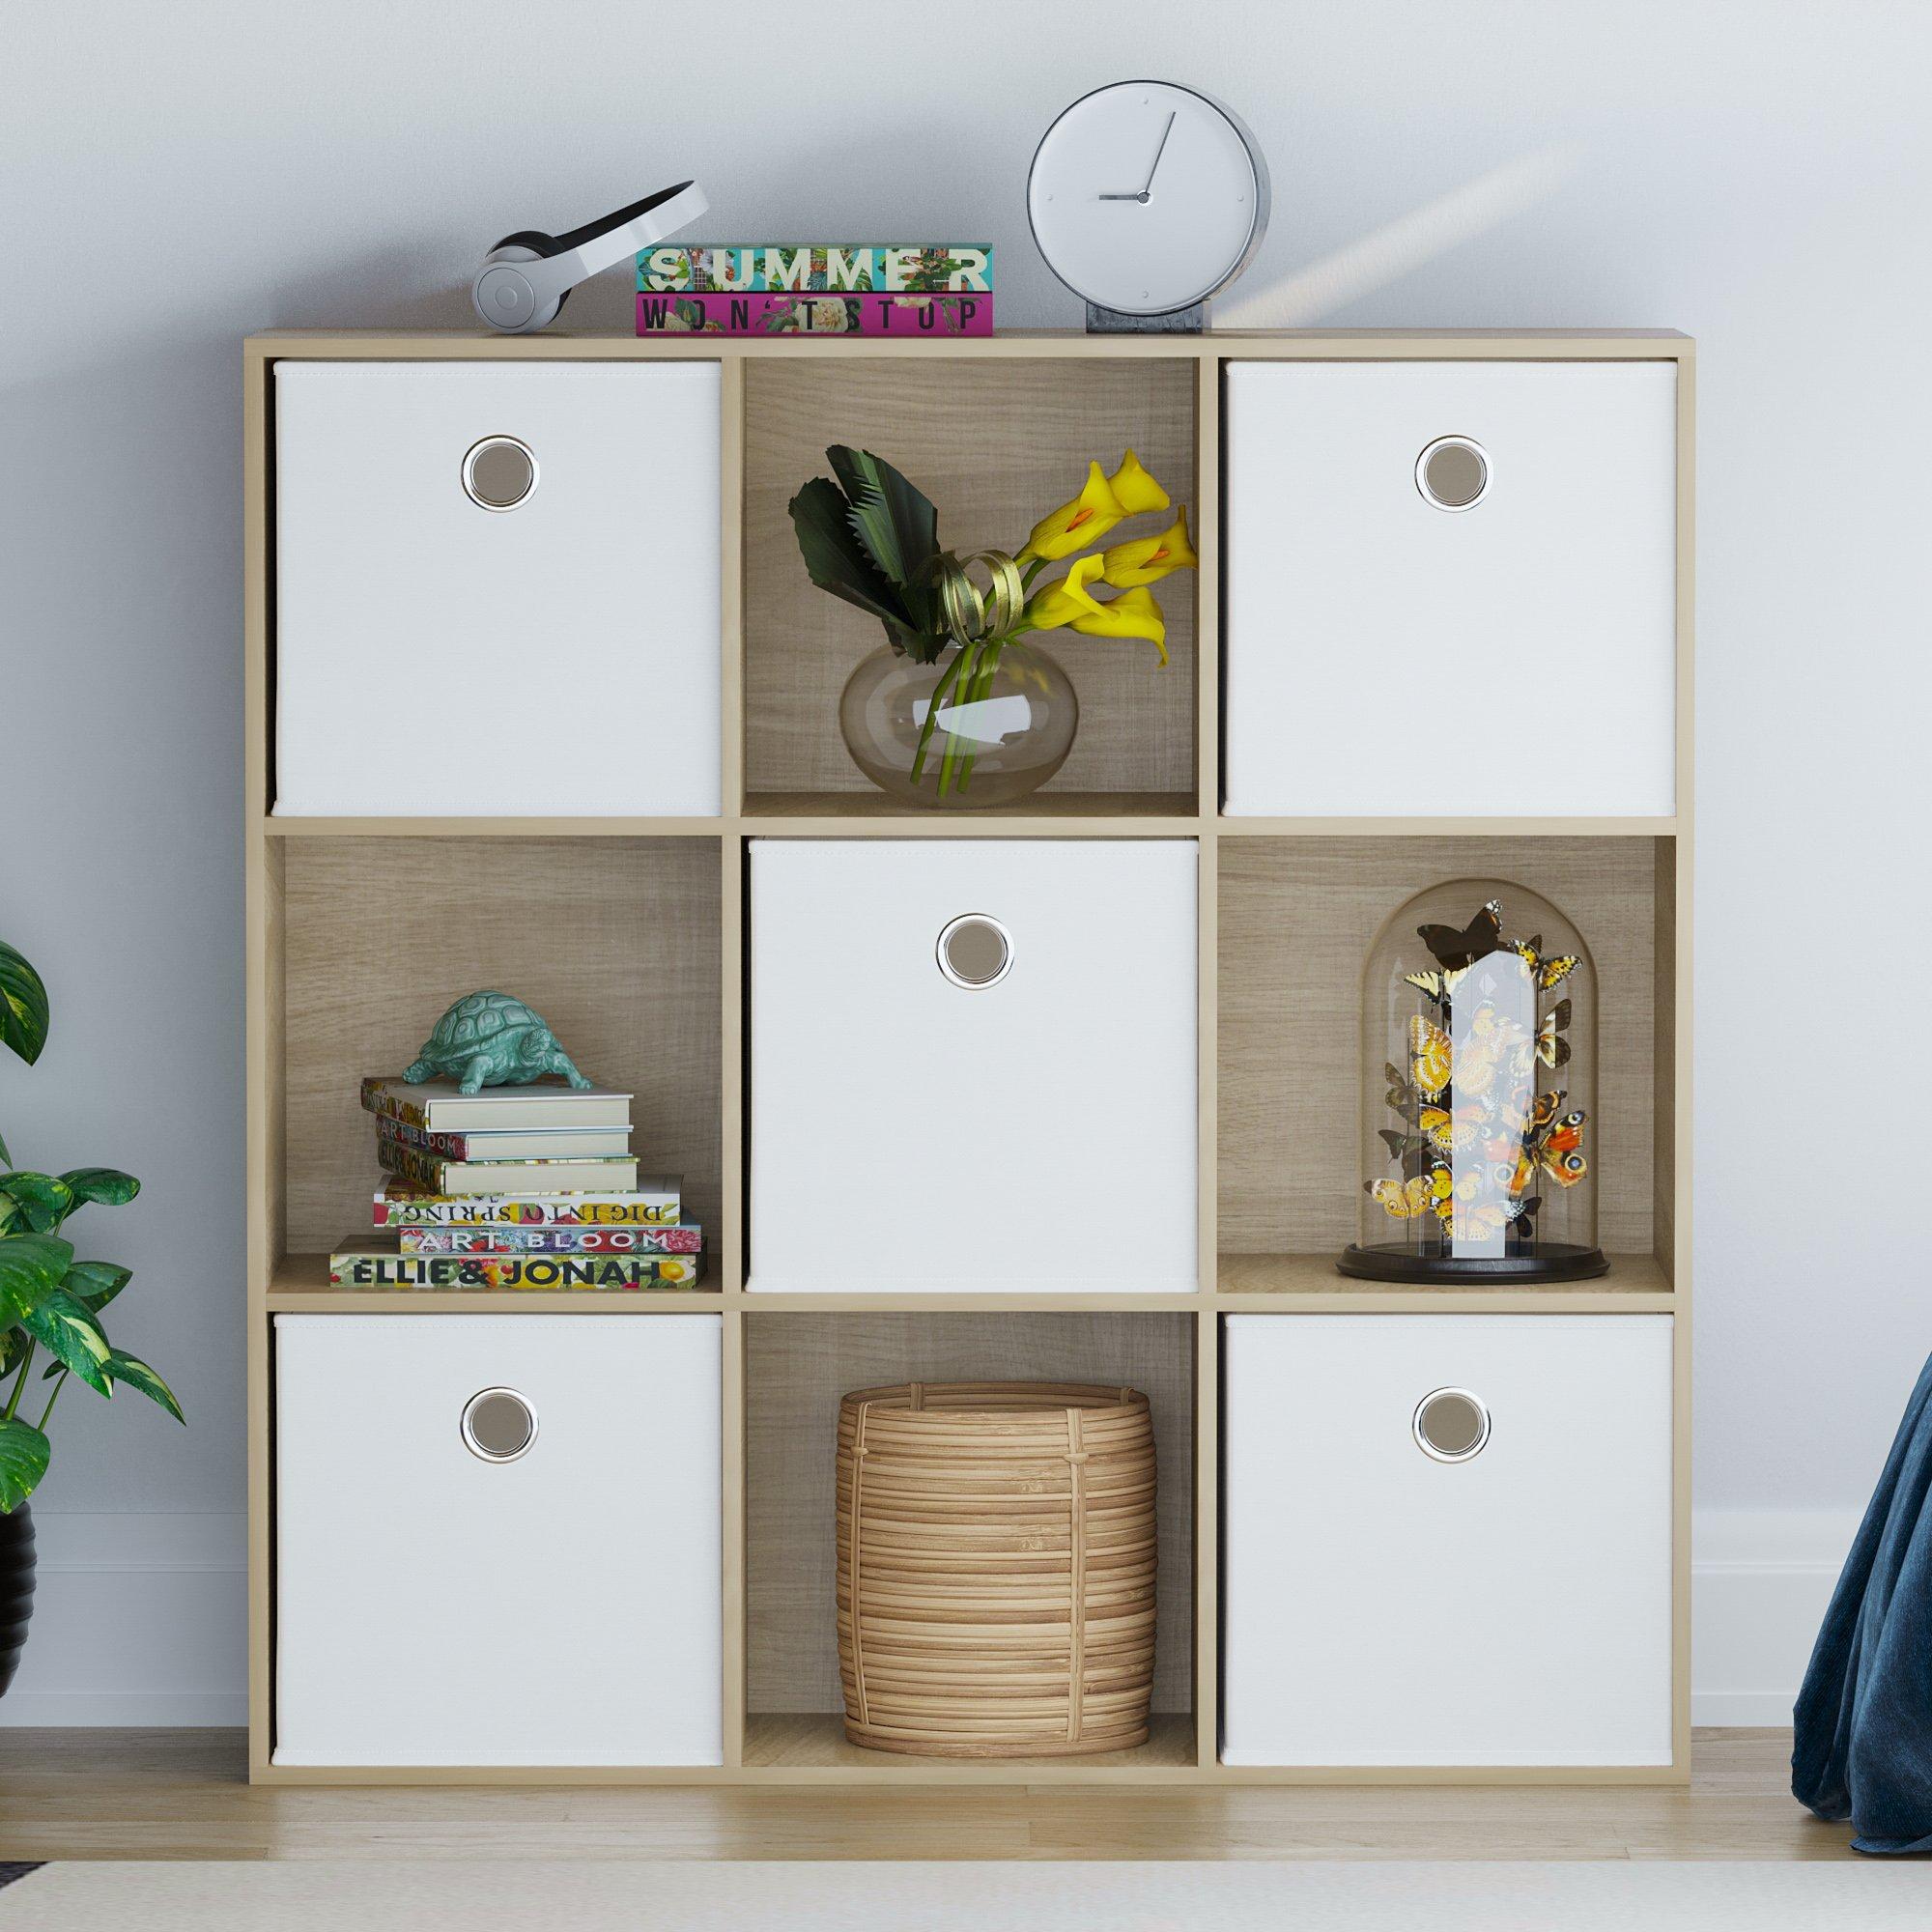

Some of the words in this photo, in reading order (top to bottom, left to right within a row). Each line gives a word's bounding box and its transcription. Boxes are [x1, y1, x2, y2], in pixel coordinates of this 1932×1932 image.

[649, 248, 990, 292] SUMMER
[846, 299, 976, 330] STOP
[382, 1121, 406, 1142] ART
[412, 1130, 456, 1153] BLOOM
[404, 1205, 511, 1222] SPRING
[526, 1205, 600, 1222] INTO
[610, 1206, 662, 1222] DIG
[417, 1232, 501, 1249] ART
[527, 1232, 668, 1249] BLOOM
[354, 1259, 449, 1284] ELLIE
[503, 1260, 660, 1285] JONAH
